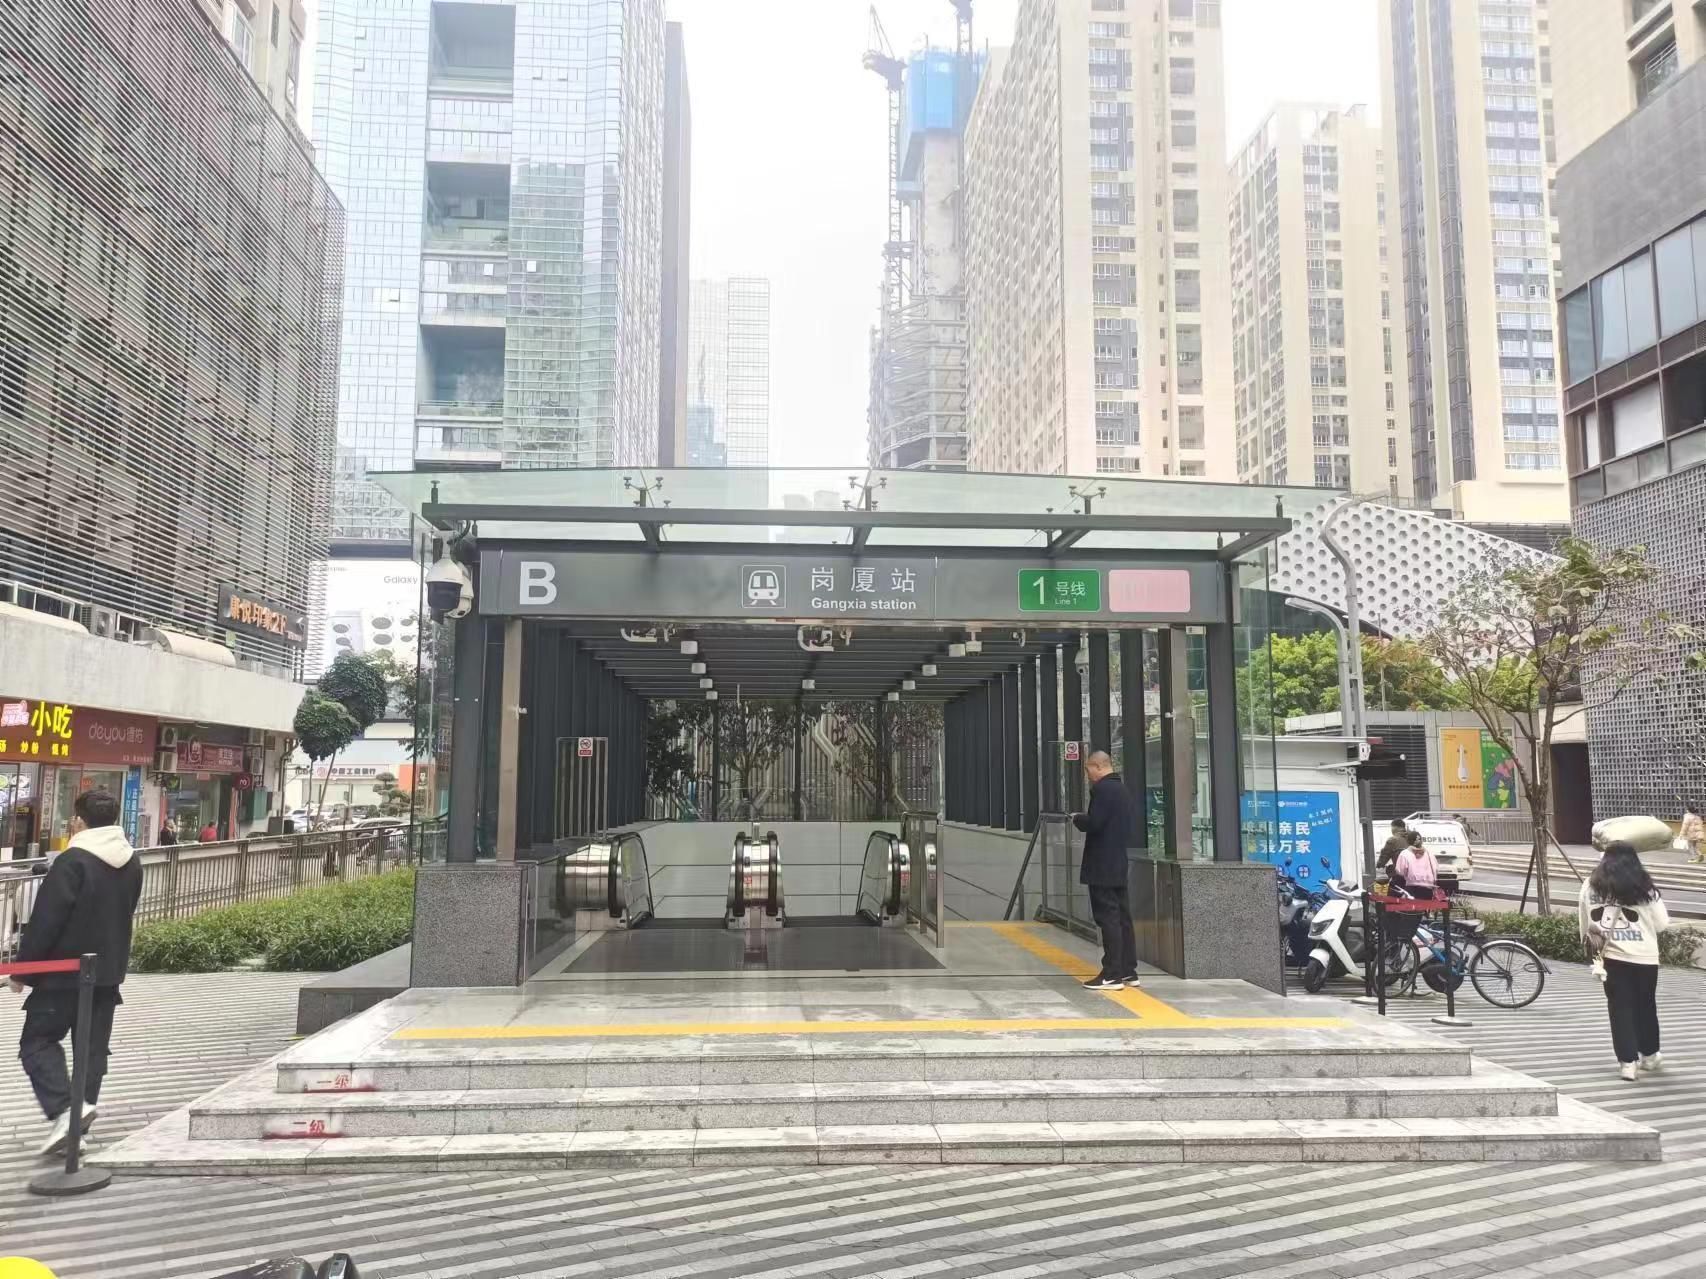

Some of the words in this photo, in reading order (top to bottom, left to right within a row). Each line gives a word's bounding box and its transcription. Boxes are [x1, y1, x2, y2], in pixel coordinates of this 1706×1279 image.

[383, 575, 418, 584] Galaxy
[520, 561, 557, 604] B
[811, 566, 916, 593] 岗厦站
[1055, 581, 1086, 596] 号线
[811, 597, 867, 611] Gangxia
[870, 598, 916, 610] station
[31, 701, 73, 738] 小吃
[88, 723, 126, 744] deyou
[316, 1074, 349, 1088] 一级
